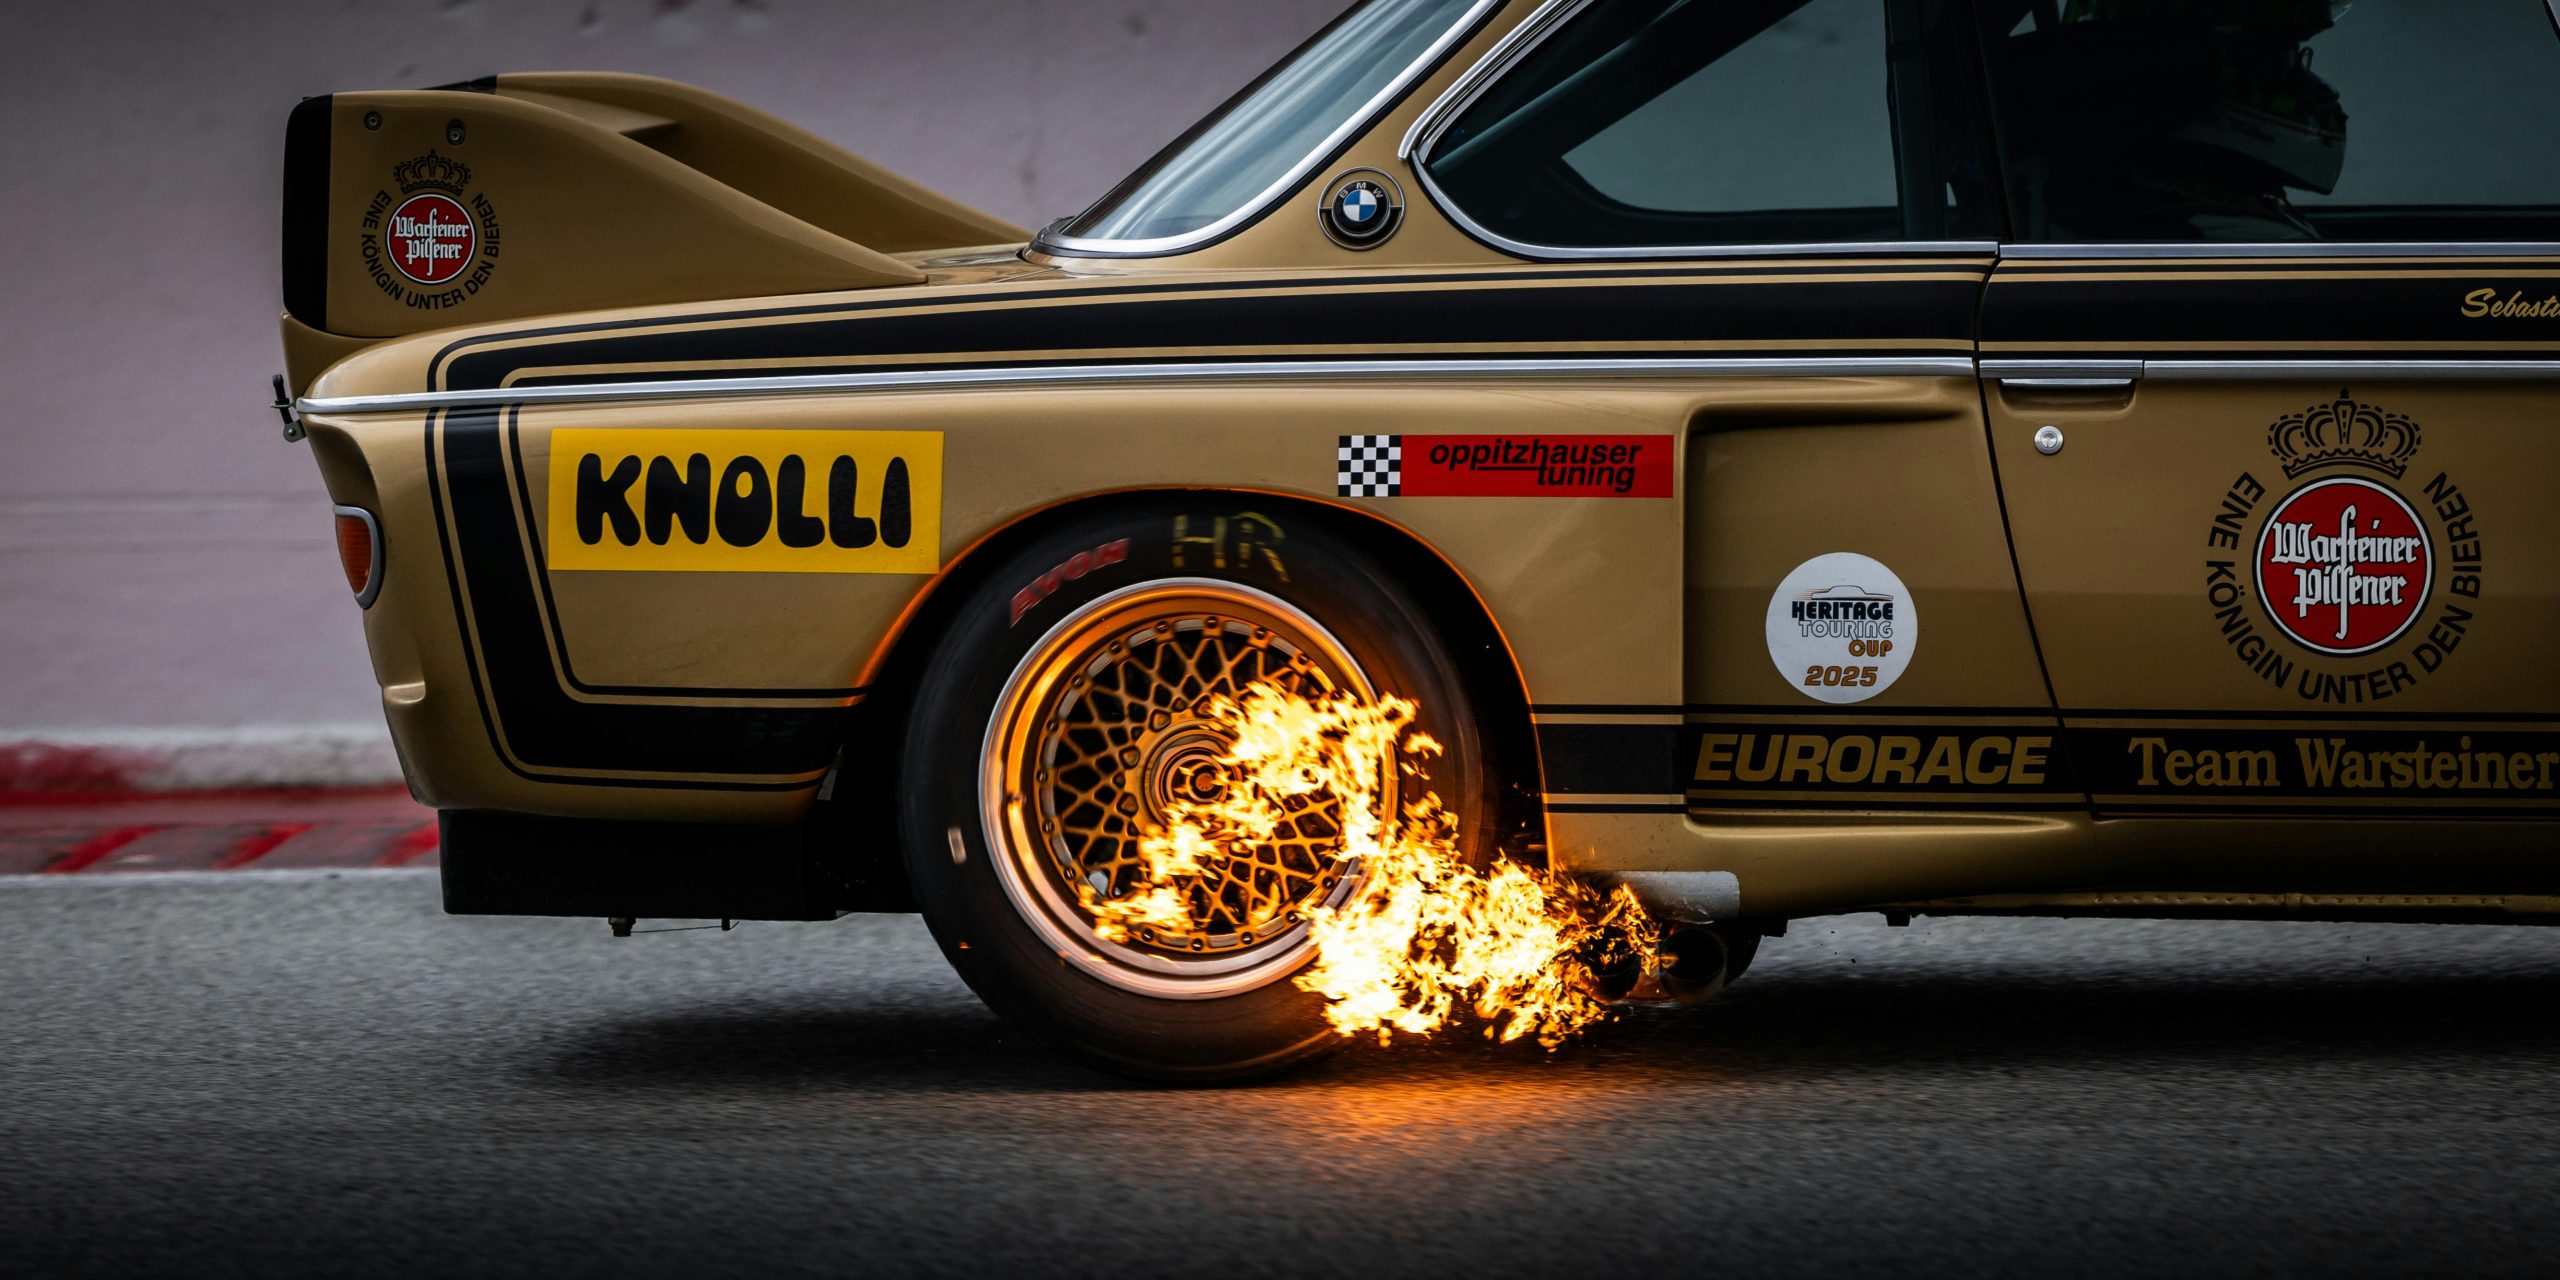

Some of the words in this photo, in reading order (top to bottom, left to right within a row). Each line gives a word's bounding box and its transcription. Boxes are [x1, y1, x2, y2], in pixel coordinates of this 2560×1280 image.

[362, 190, 393, 230] EINE
[1340, 182, 1384, 198] BMW
[472, 193, 500, 258] BIEREN
[361, 233, 405, 300] KÖNIGIN
[464, 260, 495, 296] DEN
[405, 287, 465, 310] UNTER
[2461, 288, 2560, 317] Sebasti
[1429, 439, 1643, 471] oppitzhauser
[1537, 462, 1637, 493] tuning
[576, 452, 912, 549] KNOLLI
[2207, 471, 2266, 550] EINE
[2423, 471, 2482, 599] BIEREN
[1792, 601, 1893, 623] HERITAGE
[1799, 620, 1893, 640] TOURING
[2206, 560, 2294, 689] KÖNIGIN
[1848, 639, 1893, 657] CUP
[2412, 604, 2474, 674] DEN
[1804, 665, 1879, 687] 2025
[2298, 660, 2417, 704] UNTER
[1694, 733, 2052, 785] EURORACE
[2128, 736, 2281, 787] Team
[2295, 735, 2560, 790] Warsteiner
